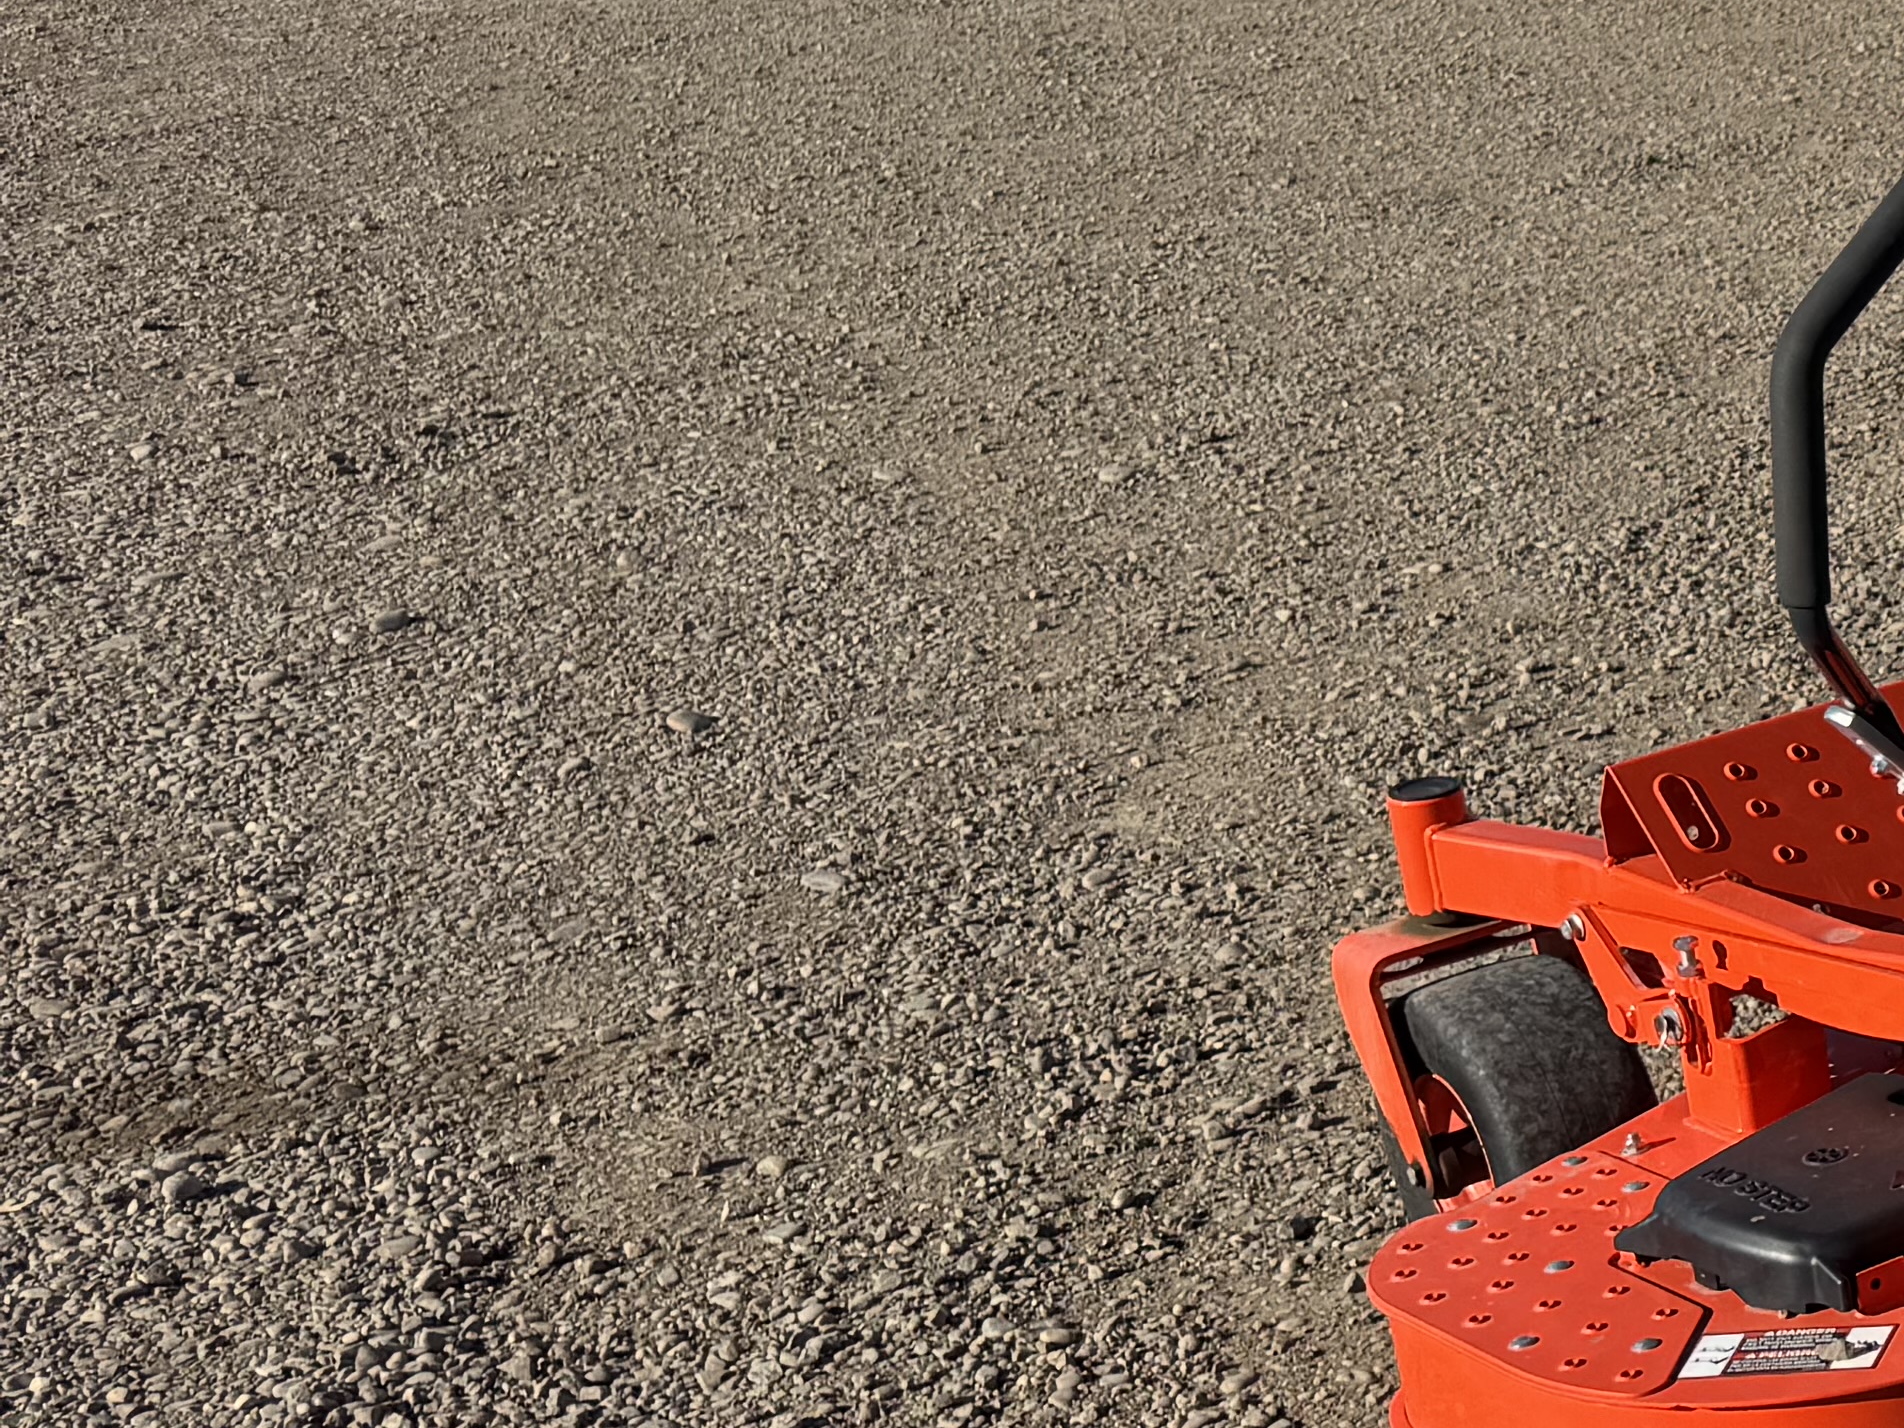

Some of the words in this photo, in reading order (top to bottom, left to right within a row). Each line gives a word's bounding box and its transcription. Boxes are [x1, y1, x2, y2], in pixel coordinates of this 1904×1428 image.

[1698, 1166, 1748, 1188] NO
[1734, 1179, 1812, 1213] STEP
[1776, 1327, 1837, 1336] DANGER
